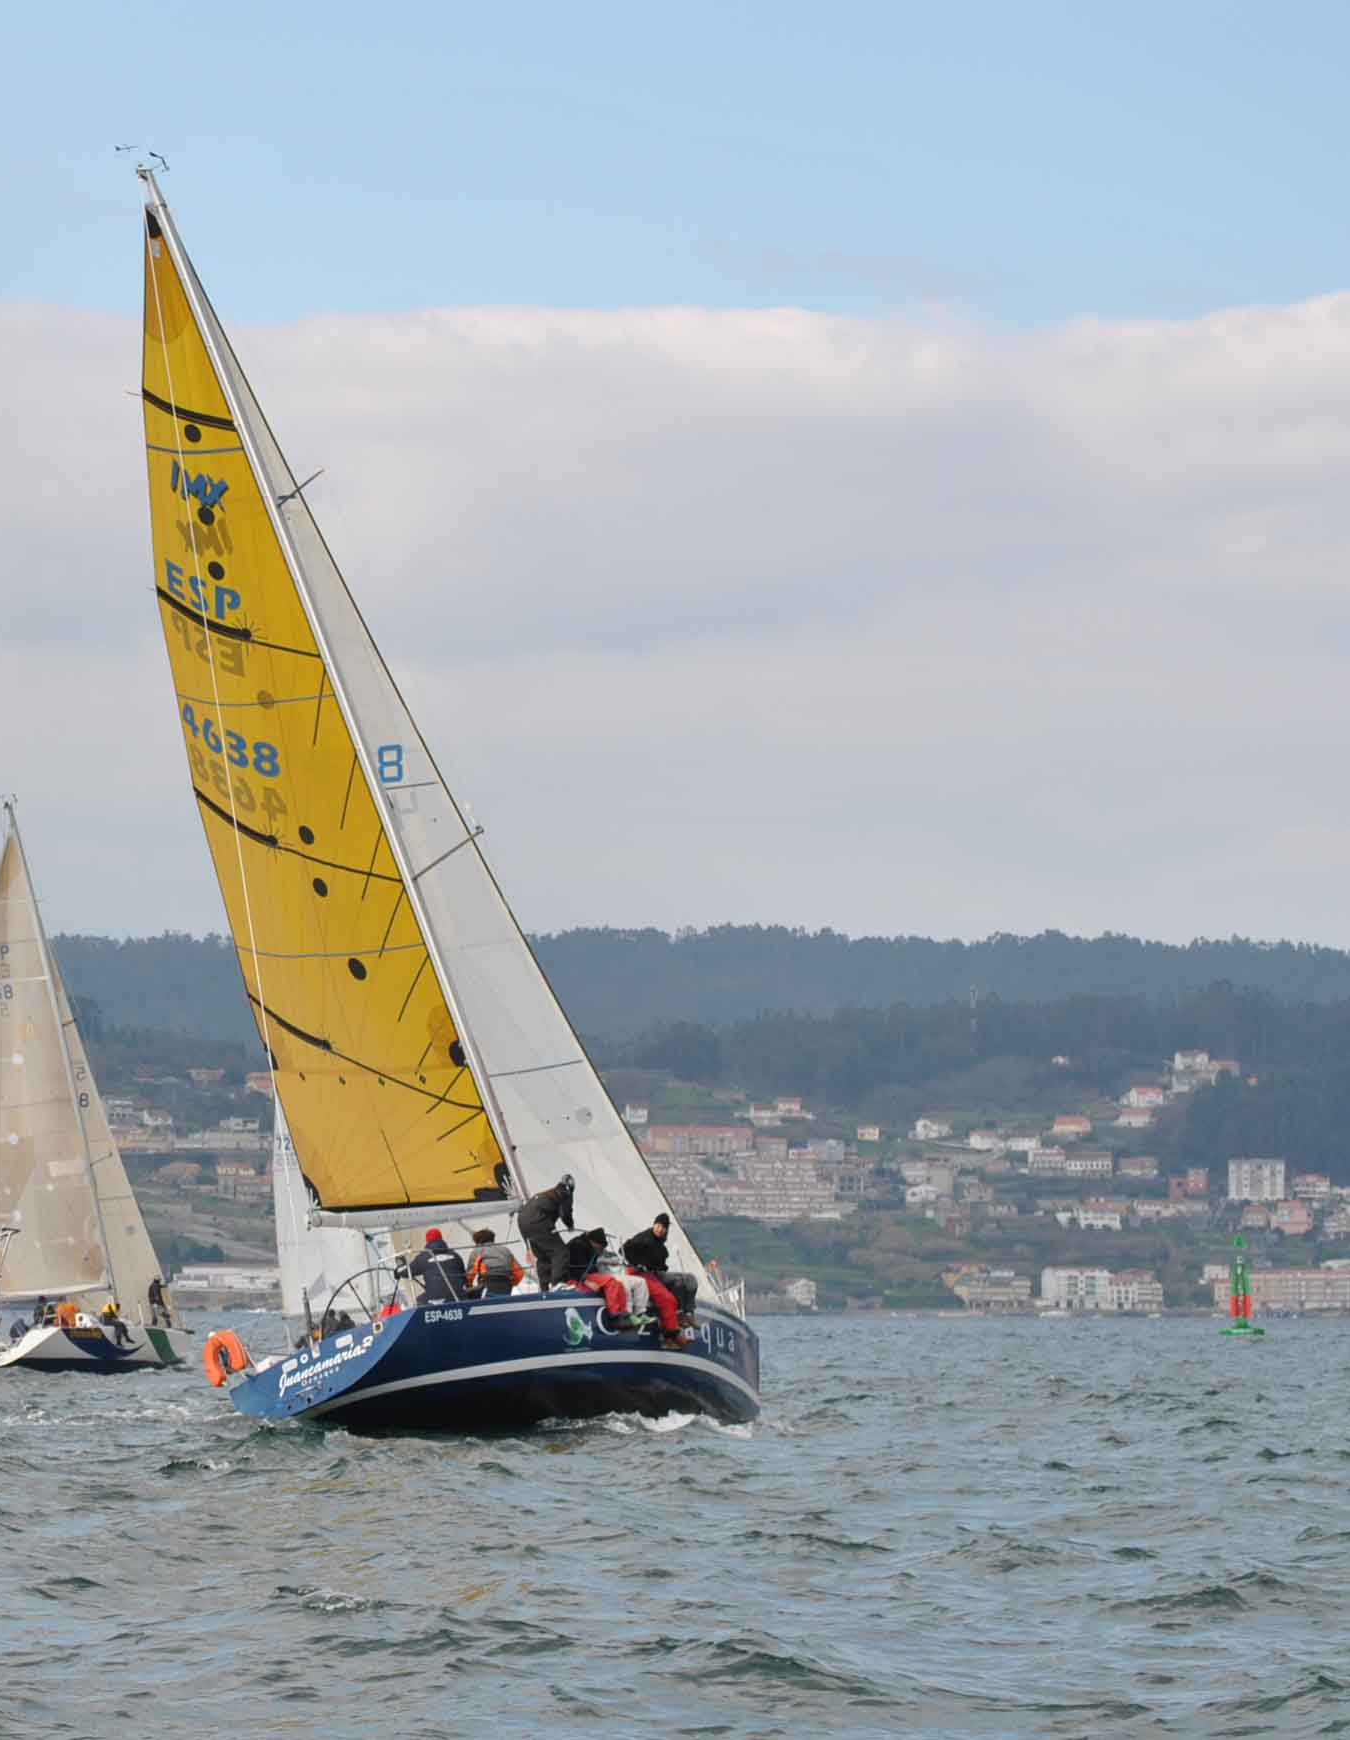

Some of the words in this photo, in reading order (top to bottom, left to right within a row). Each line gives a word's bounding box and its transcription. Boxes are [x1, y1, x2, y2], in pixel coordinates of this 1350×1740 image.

[165, 558, 241, 620] ESP
[183, 703, 281, 778] 4638
[424, 1308, 463, 1323] ESP-4638
